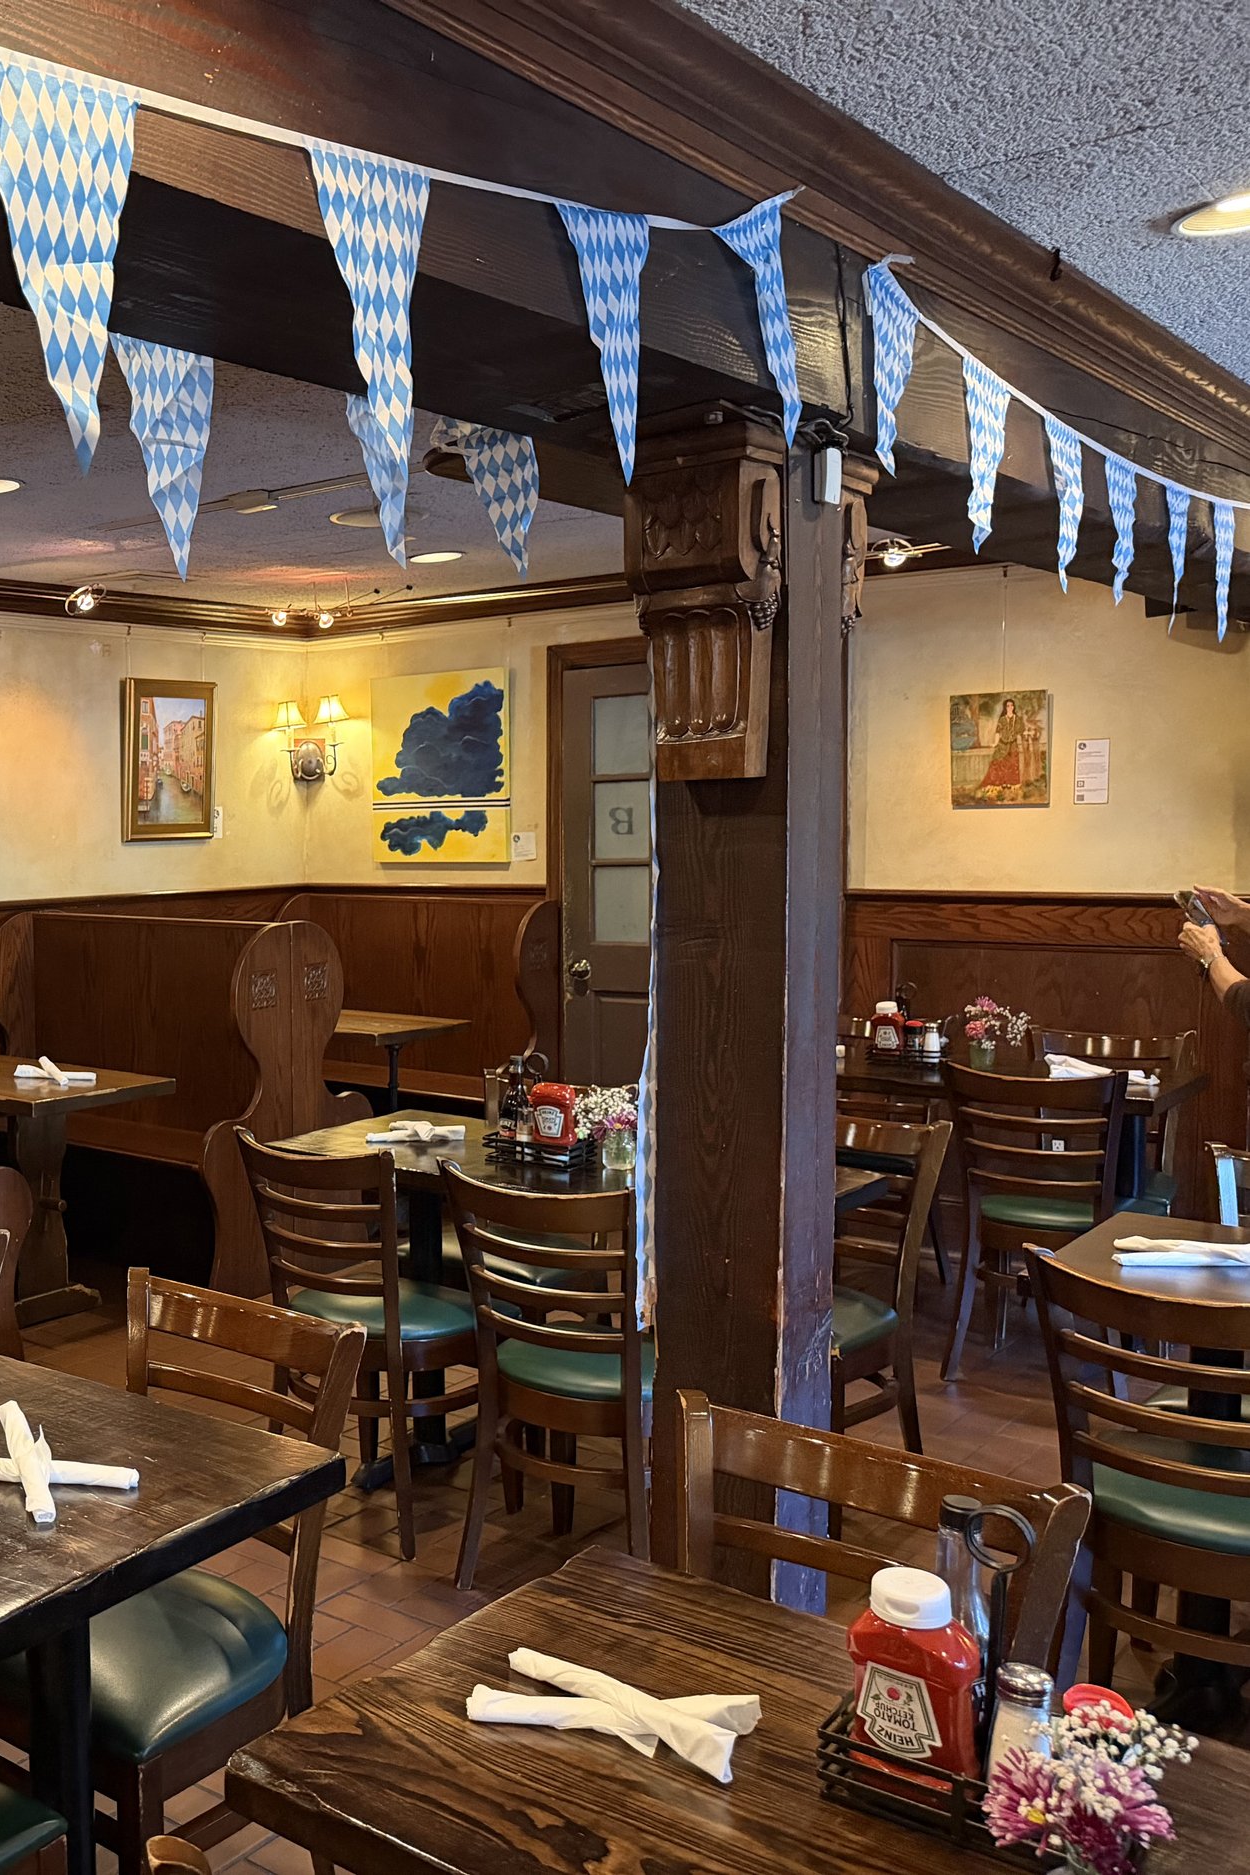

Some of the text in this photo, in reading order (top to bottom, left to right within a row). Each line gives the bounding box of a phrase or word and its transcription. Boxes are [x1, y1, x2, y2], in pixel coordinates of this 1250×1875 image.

[873, 1707, 918, 1732] TOMATO
[875, 1701, 915, 1721] KETCHUP
[877, 1724, 915, 1747] HEINZ
